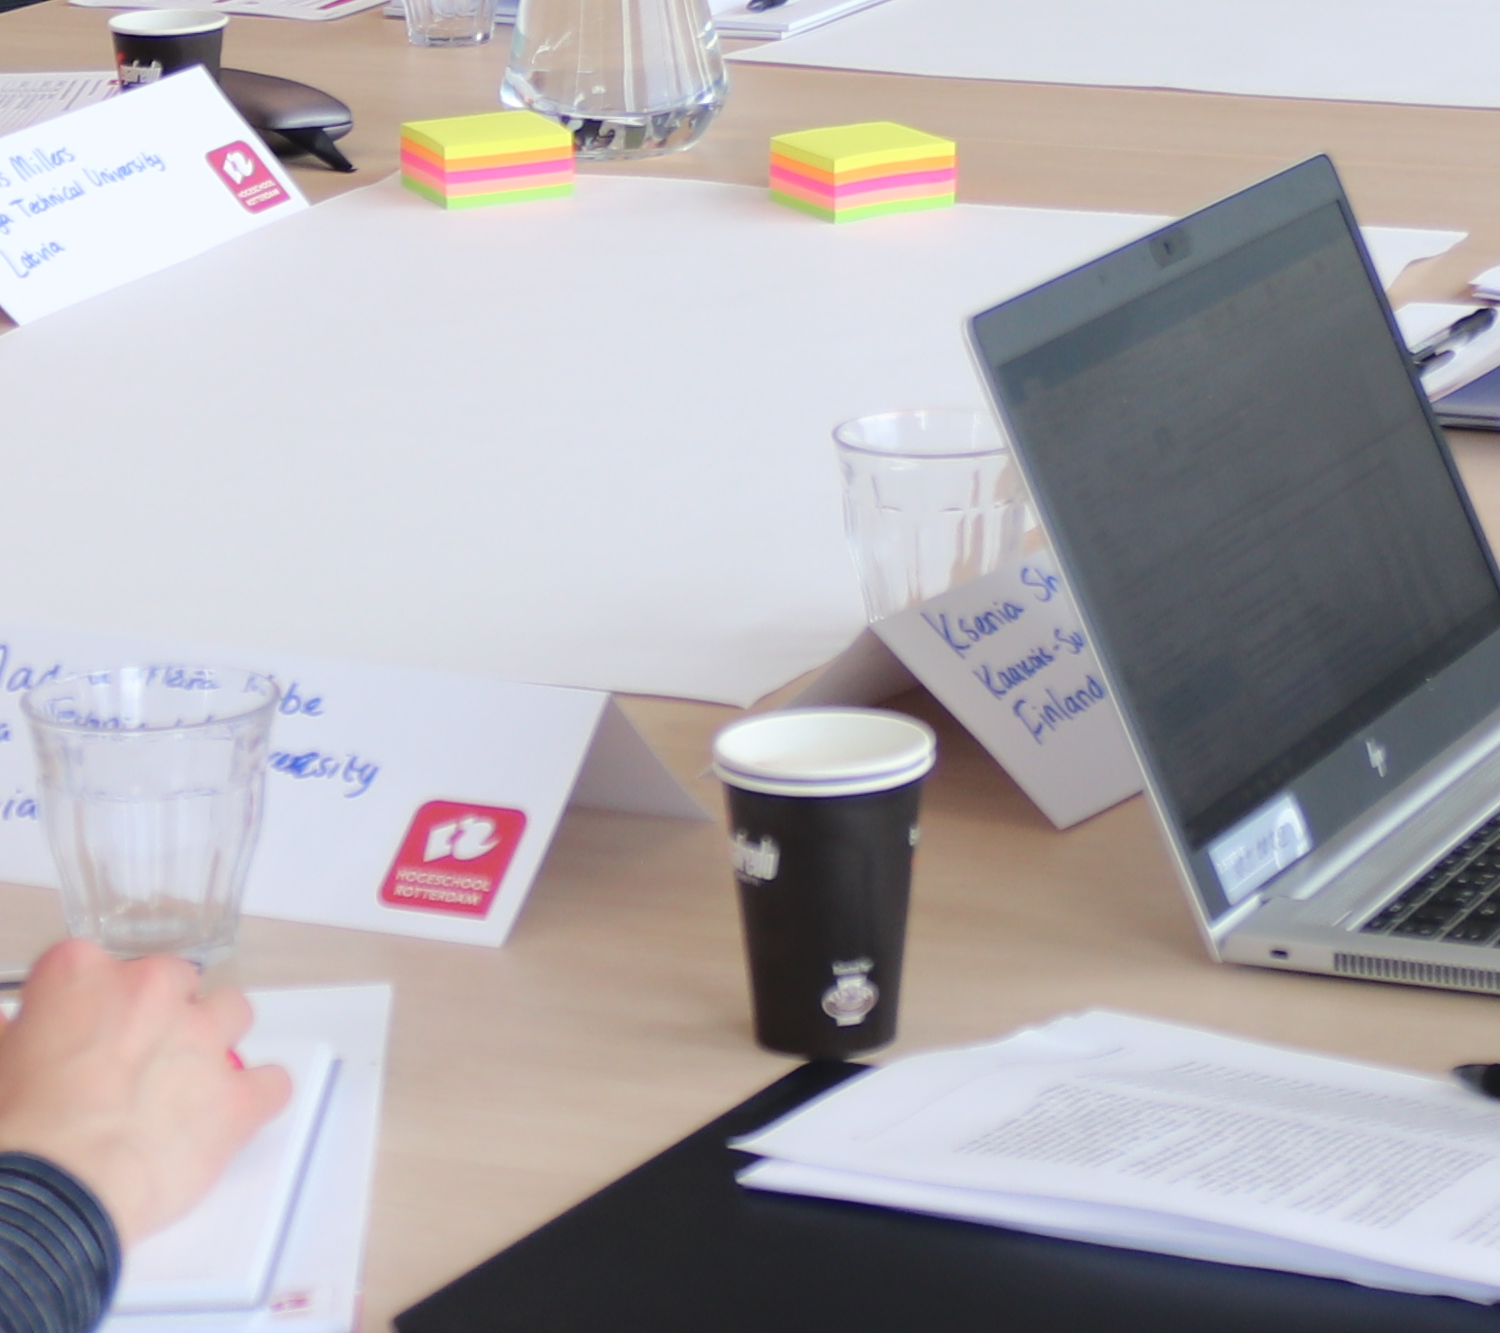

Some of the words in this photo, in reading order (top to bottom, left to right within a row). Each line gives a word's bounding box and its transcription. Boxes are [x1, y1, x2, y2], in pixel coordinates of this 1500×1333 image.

[8, 181, 86, 219] Technical
[82, 150, 168, 187] University
[919, 600, 1025, 660] Ksenia
[1011, 674, 1106, 746] Finland
[393, 884, 483, 906] ROTTERDAM
[394, 870, 492, 893] HOGESCHOOL
